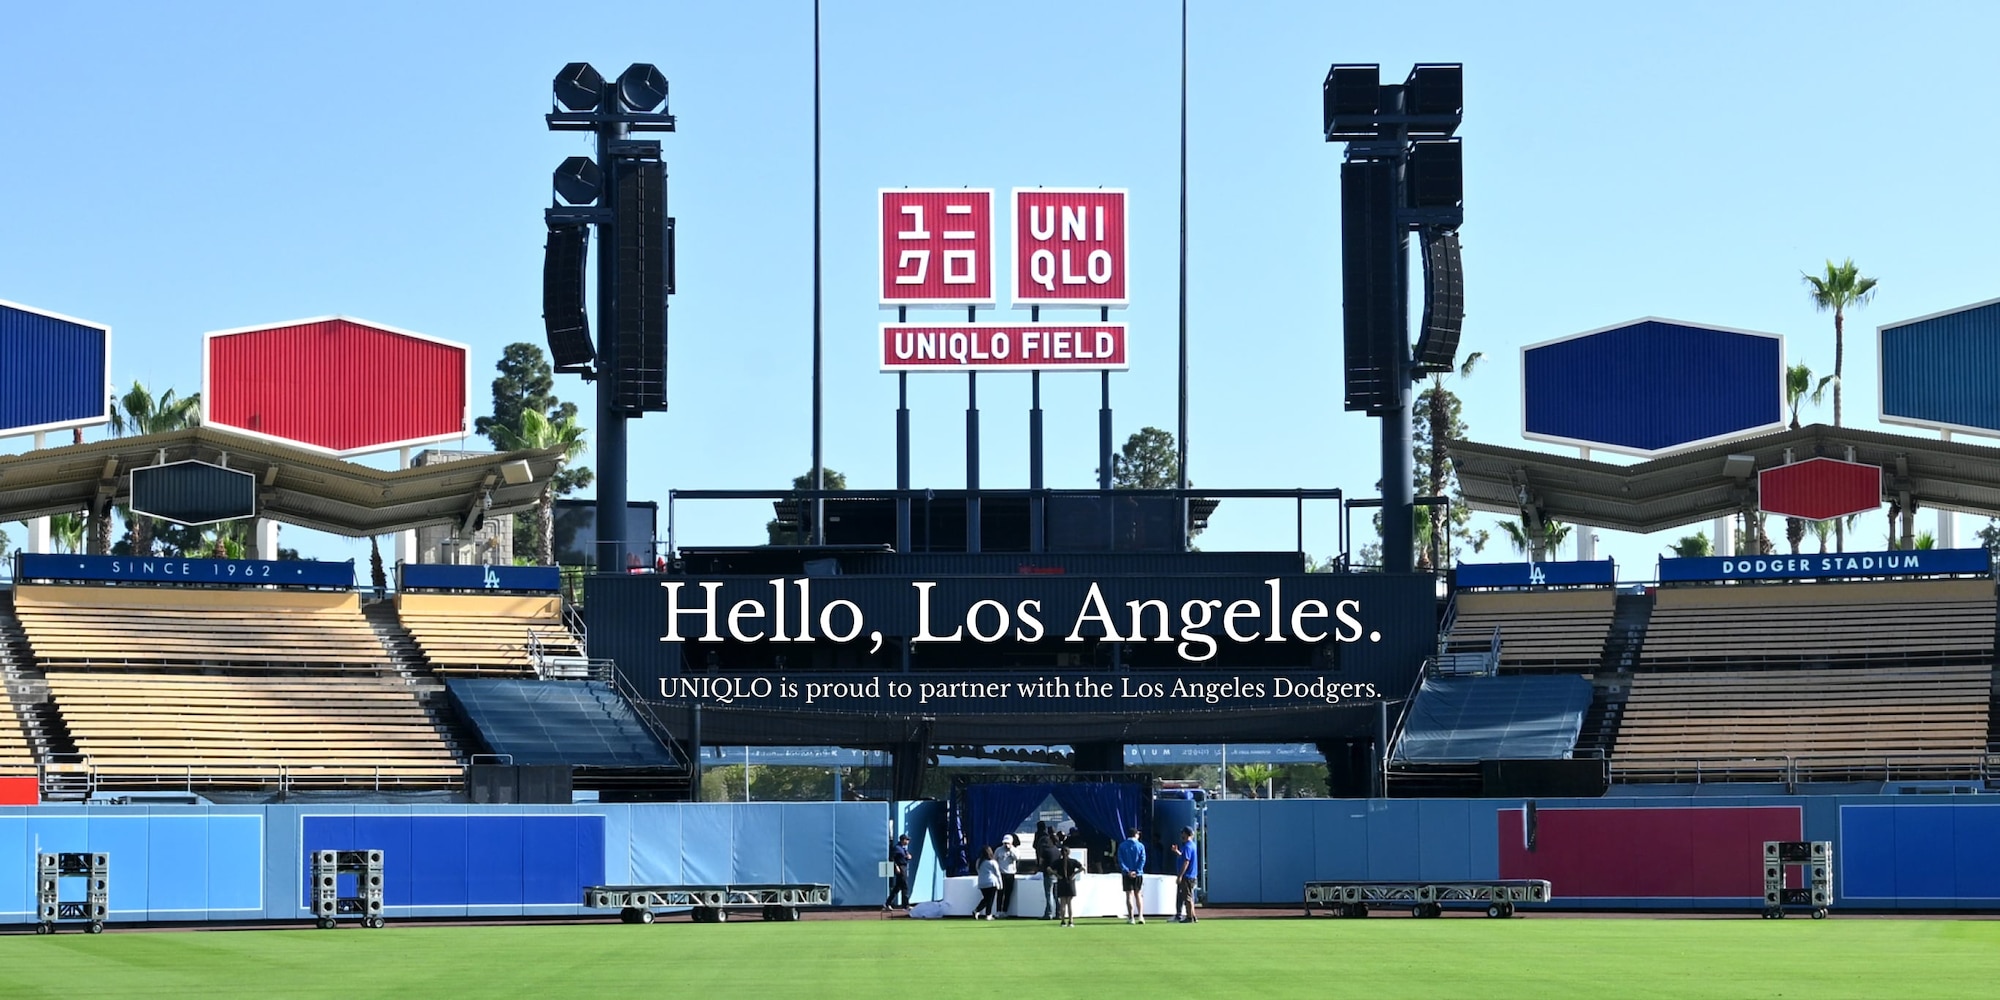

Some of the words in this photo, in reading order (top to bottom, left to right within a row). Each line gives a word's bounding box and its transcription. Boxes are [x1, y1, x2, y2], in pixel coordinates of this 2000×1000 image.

[1030, 205, 1105, 241] UNI
[1030, 248, 1112, 291] QLO
[895, 332, 1010, 364] UNIQLO
[1022, 332, 1114, 359] FIELD
[112, 560, 190, 575] SINCE
[213, 563, 271, 577] 1962
[483, 563, 500, 588] LA
[1529, 561, 1546, 585] LA
[1722, 558, 1810, 574] DODGER
[1821, 555, 1920, 571] STADIUM
